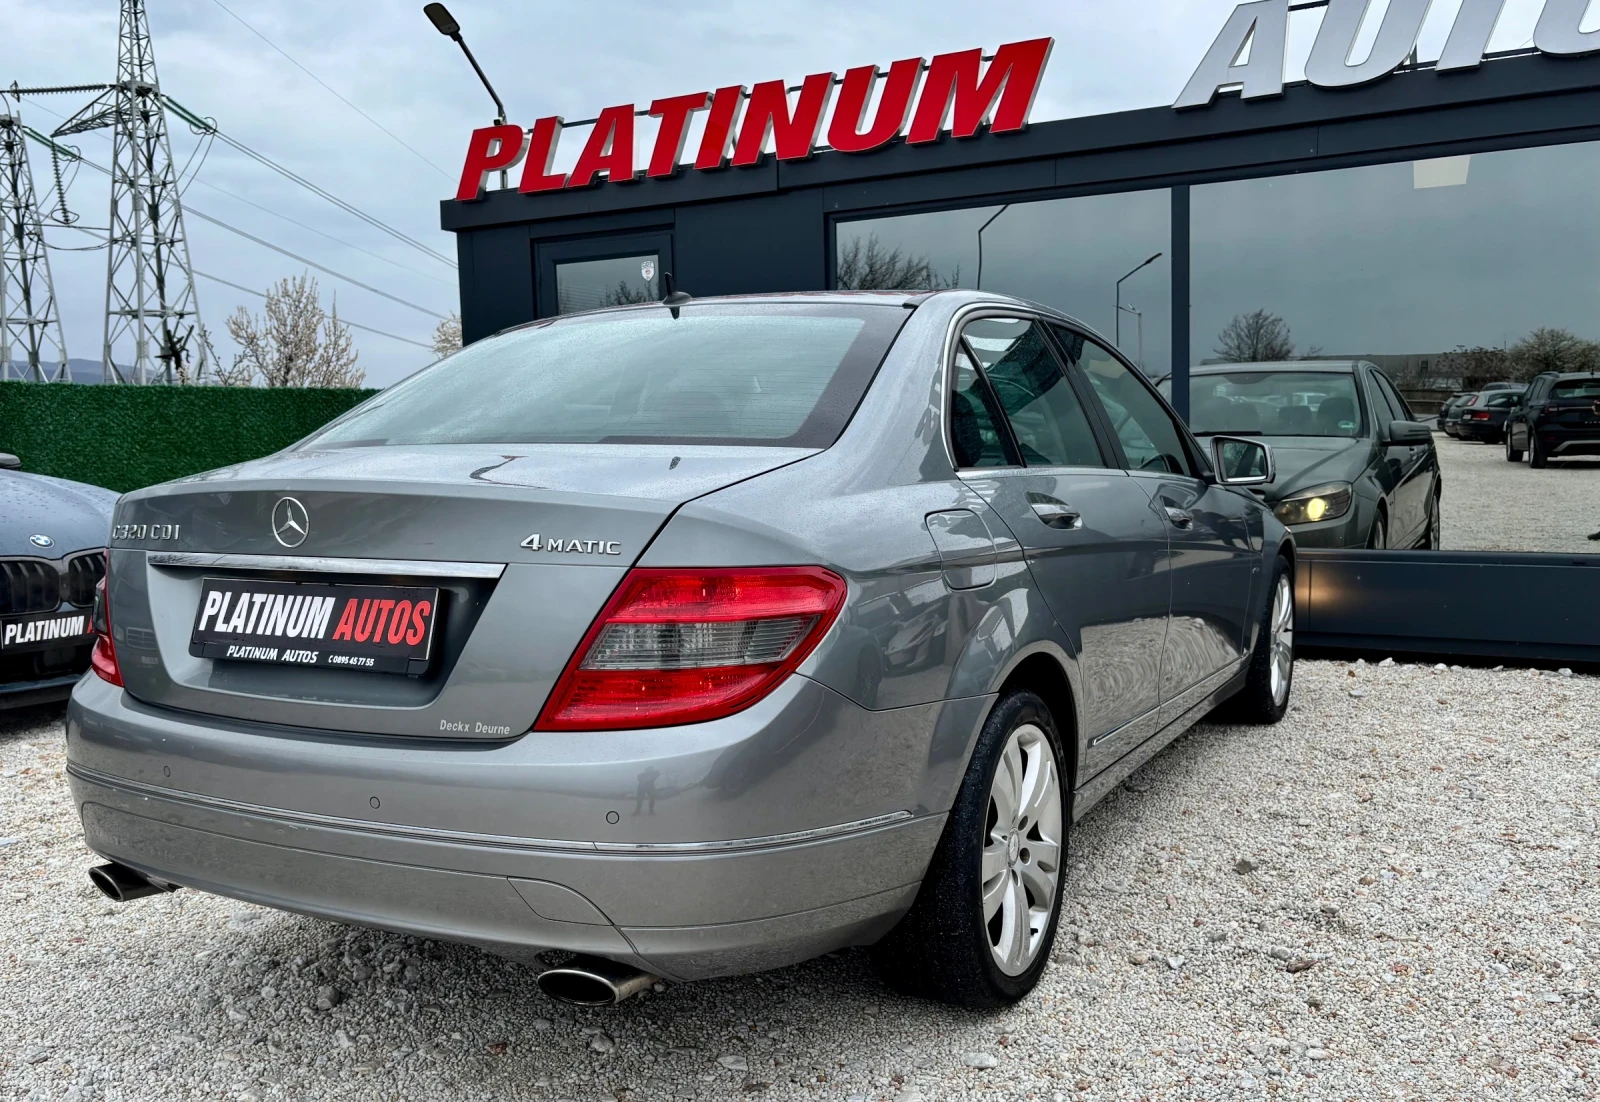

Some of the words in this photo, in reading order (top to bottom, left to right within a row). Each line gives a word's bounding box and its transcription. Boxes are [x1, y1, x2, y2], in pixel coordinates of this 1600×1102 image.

[455, 36, 1054, 201] PLATINUM
[112, 524, 147, 540] C320
[150, 524, 180, 540] CDI
[4, 615, 85, 645] PLATINUM
[198, 590, 336, 639] PLATINUM
[332, 598, 431, 646] AUTOS
[226, 645, 278, 661] PLATINUM
[281, 649, 319, 663] AUTOS
[440, 719, 470, 732] Deckx
[475, 721, 510, 735] Deurne
